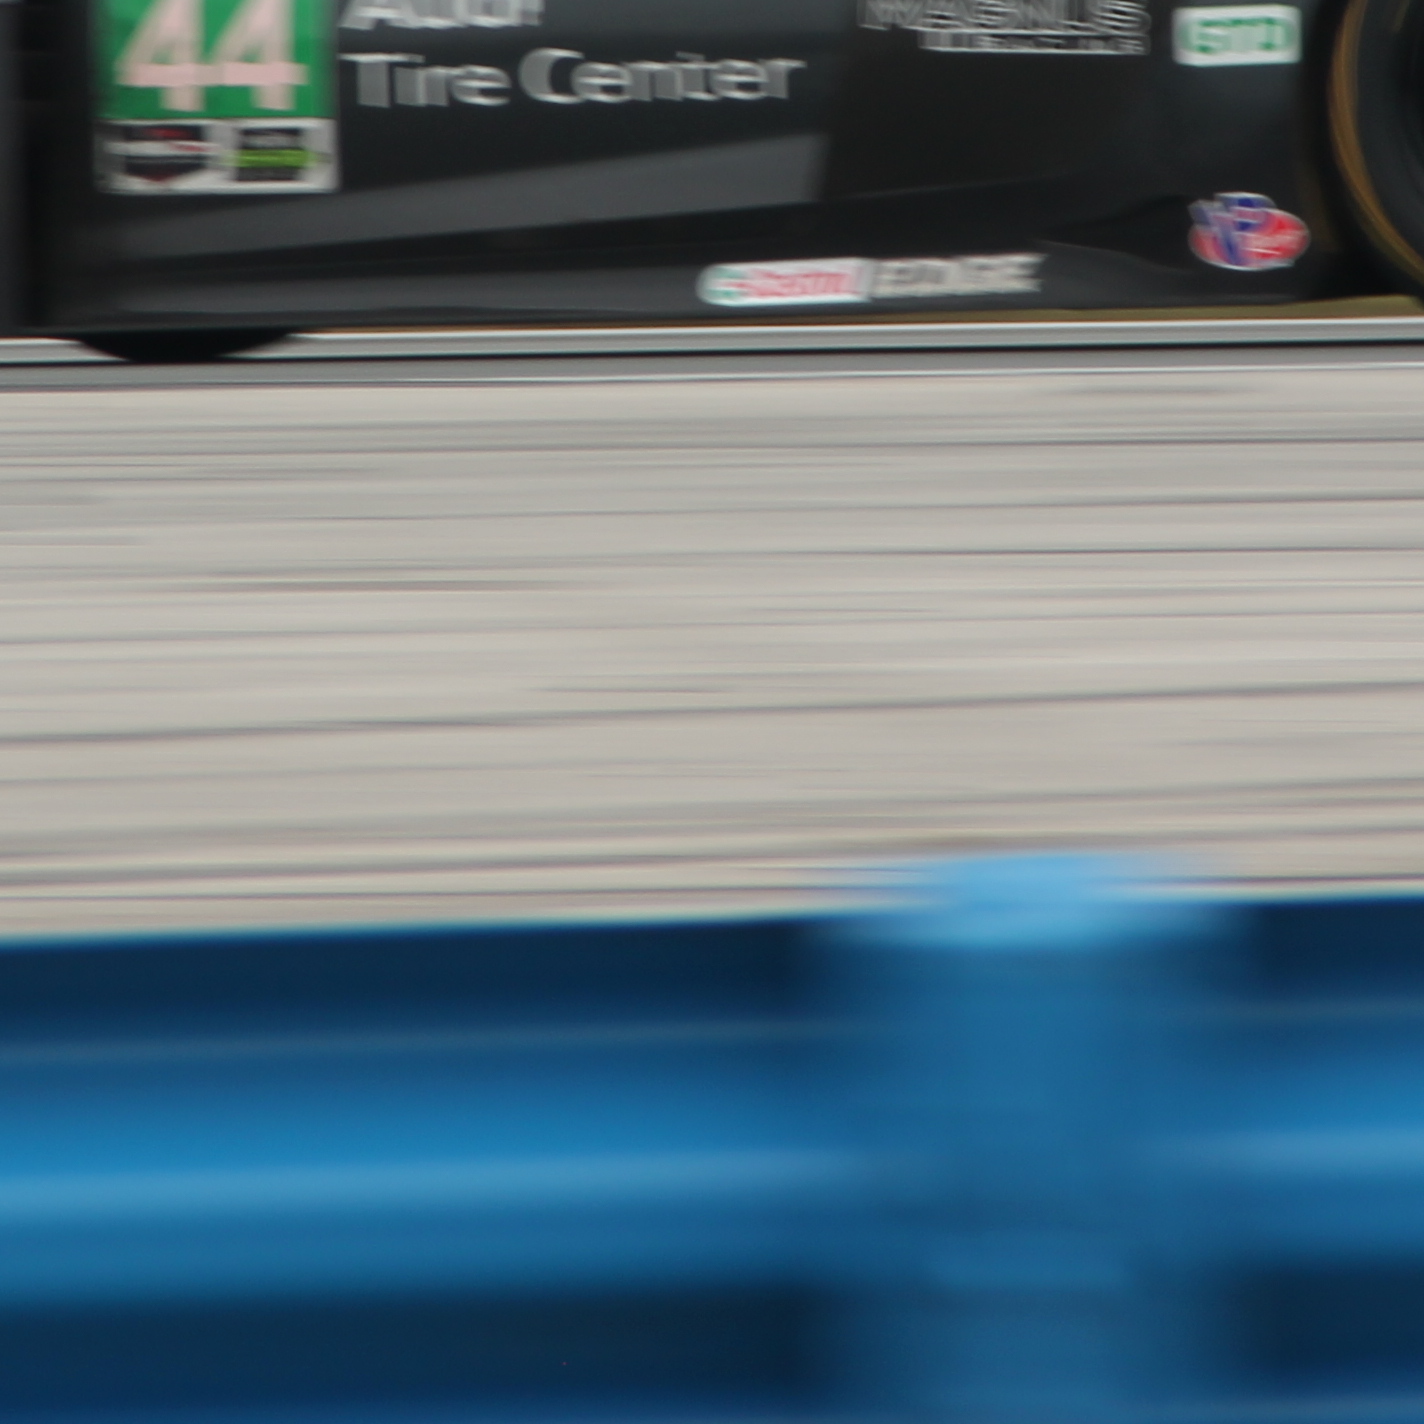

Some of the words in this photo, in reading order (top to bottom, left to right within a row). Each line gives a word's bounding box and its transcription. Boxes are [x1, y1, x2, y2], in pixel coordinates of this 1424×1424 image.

[1182, 16, 1293, 55] GTD
[338, 52, 511, 108] Tire
[519, 46, 807, 105] Center
